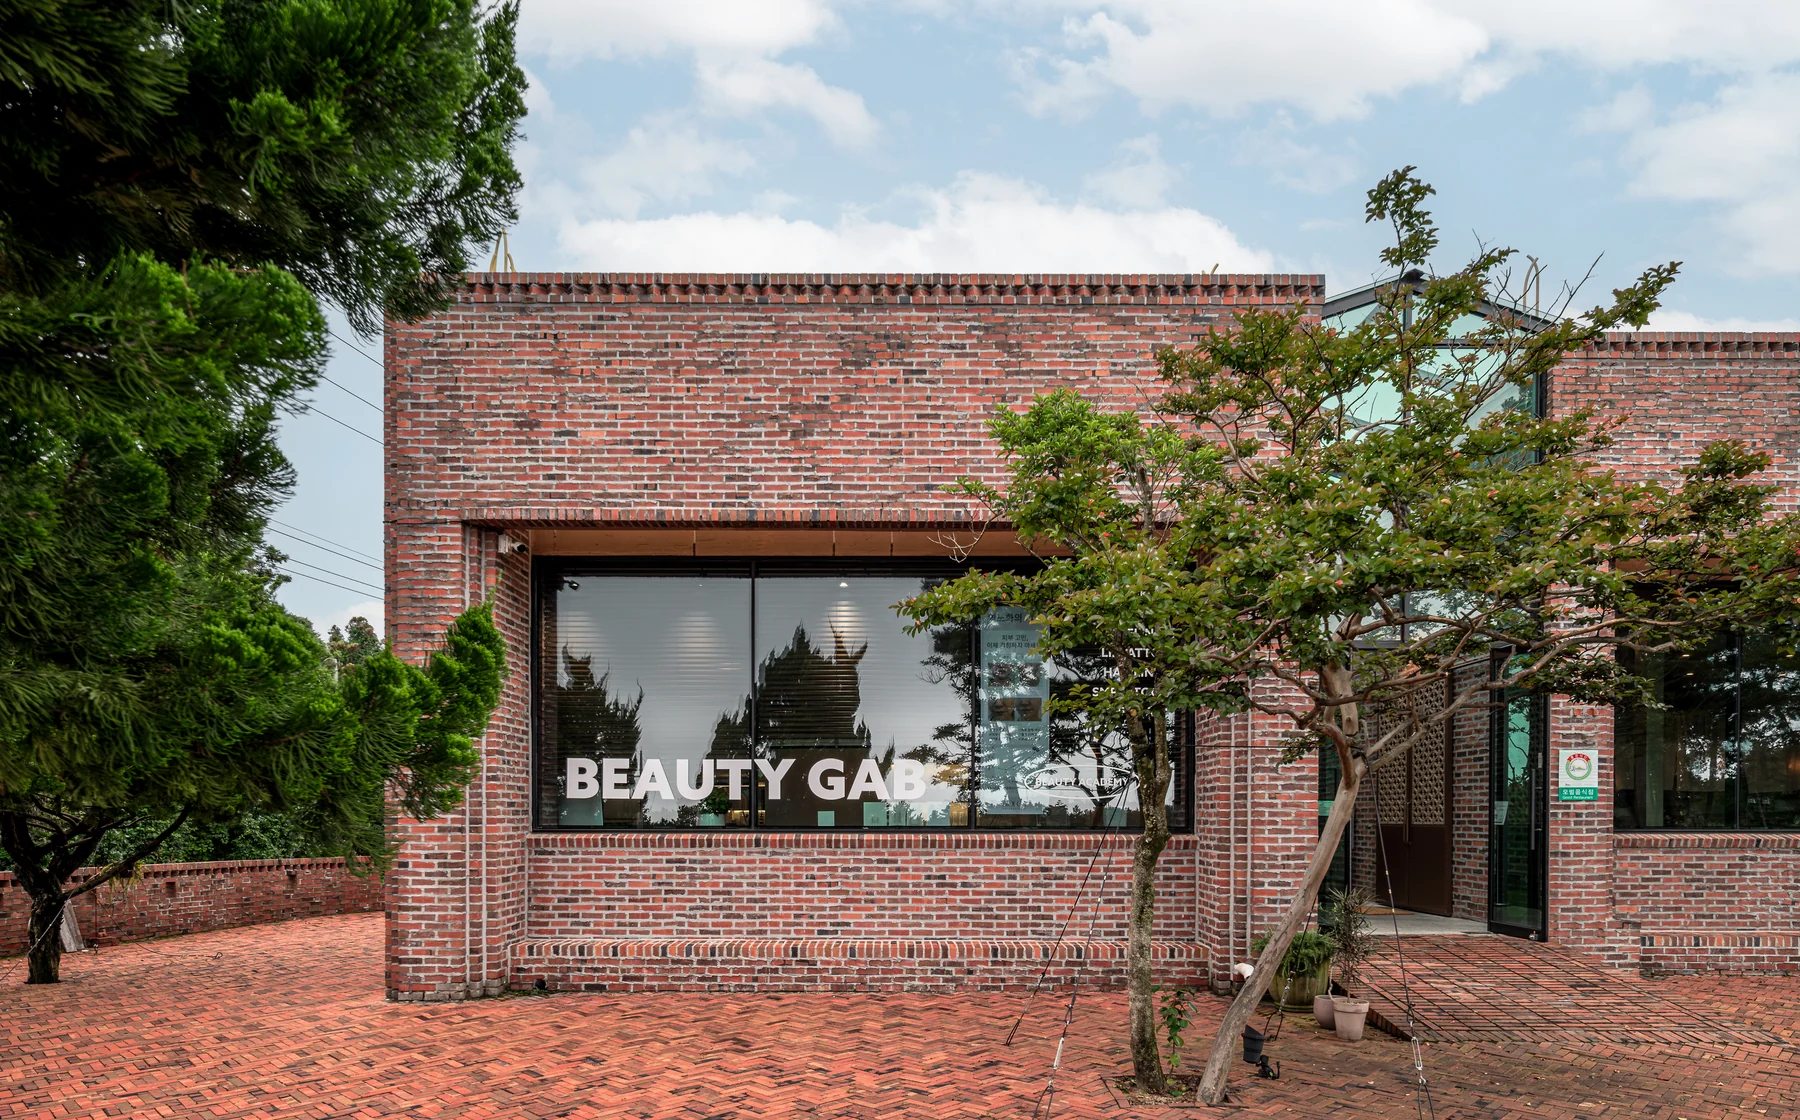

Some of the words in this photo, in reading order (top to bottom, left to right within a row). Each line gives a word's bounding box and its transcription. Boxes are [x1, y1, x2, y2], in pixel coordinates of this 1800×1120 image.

[986, 641, 998, 649] 이제
[1024, 641, 1039, 649] 마세
[566, 757, 797, 801] BEAUTY
[807, 757, 927, 801] GAB
[1035, 777, 1077, 787] BEAUTY
[1078, 777, 1129, 787] ACADEMY
